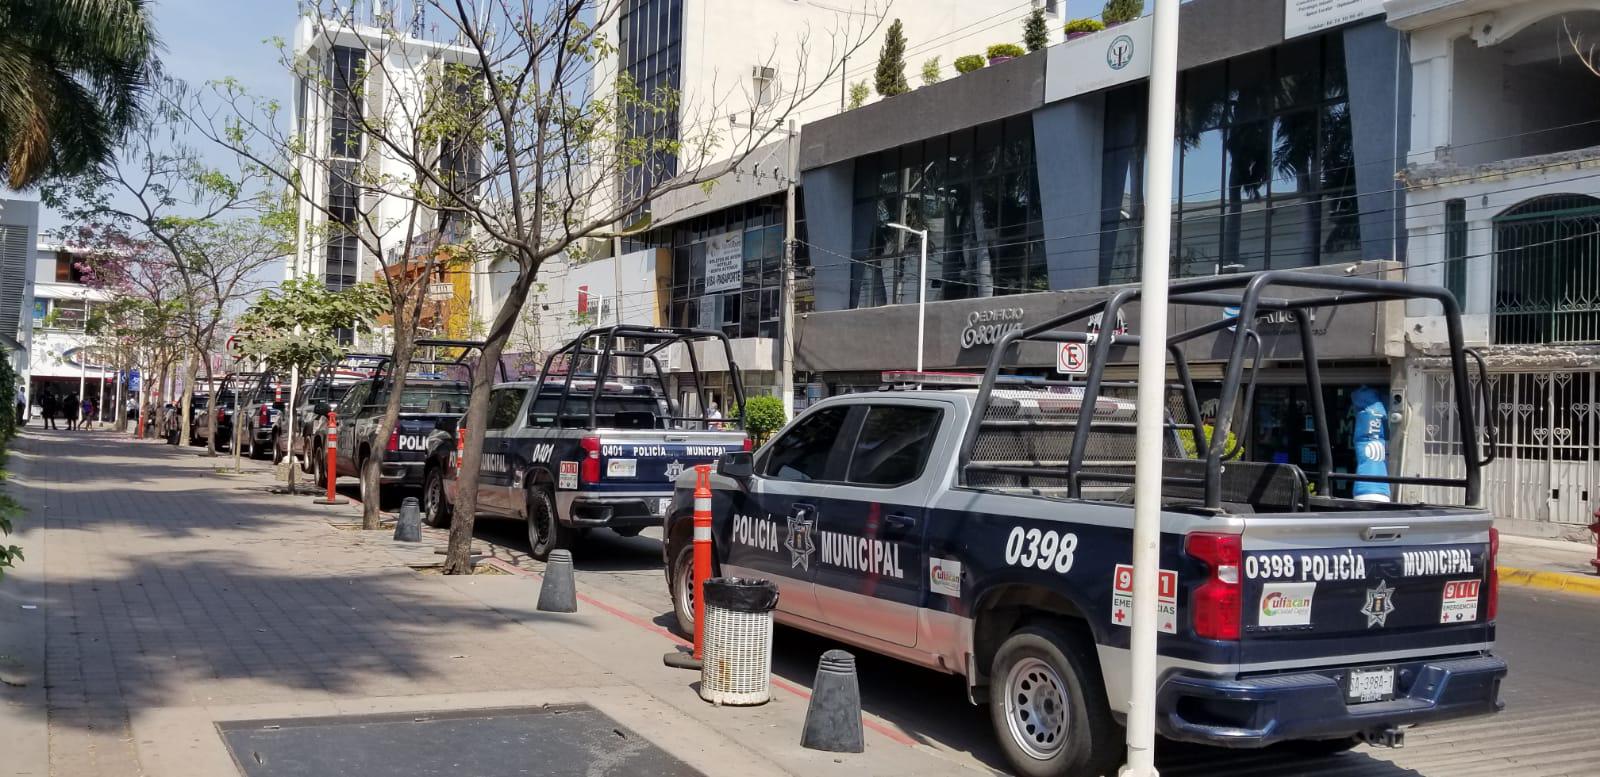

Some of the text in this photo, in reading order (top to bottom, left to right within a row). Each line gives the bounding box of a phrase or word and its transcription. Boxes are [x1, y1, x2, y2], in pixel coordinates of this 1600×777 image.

[979, 307, 1024, 322] EDIFICIO
[1068, 346, 1078, 366] E
[532, 443, 555, 464] 0401
[602, 444, 623, 457] 0401
[480, 453, 507, 473] UNICIPAL
[732, 513, 904, 579] POLICÍA MUNICIPAL
[1005, 526, 1078, 574] 0398
[1245, 554, 1296, 580] 0398
[1402, 548, 1475, 577] MUNICIPAL
[1118, 570, 1170, 594] 91
[1446, 582, 1478, 600] 911
